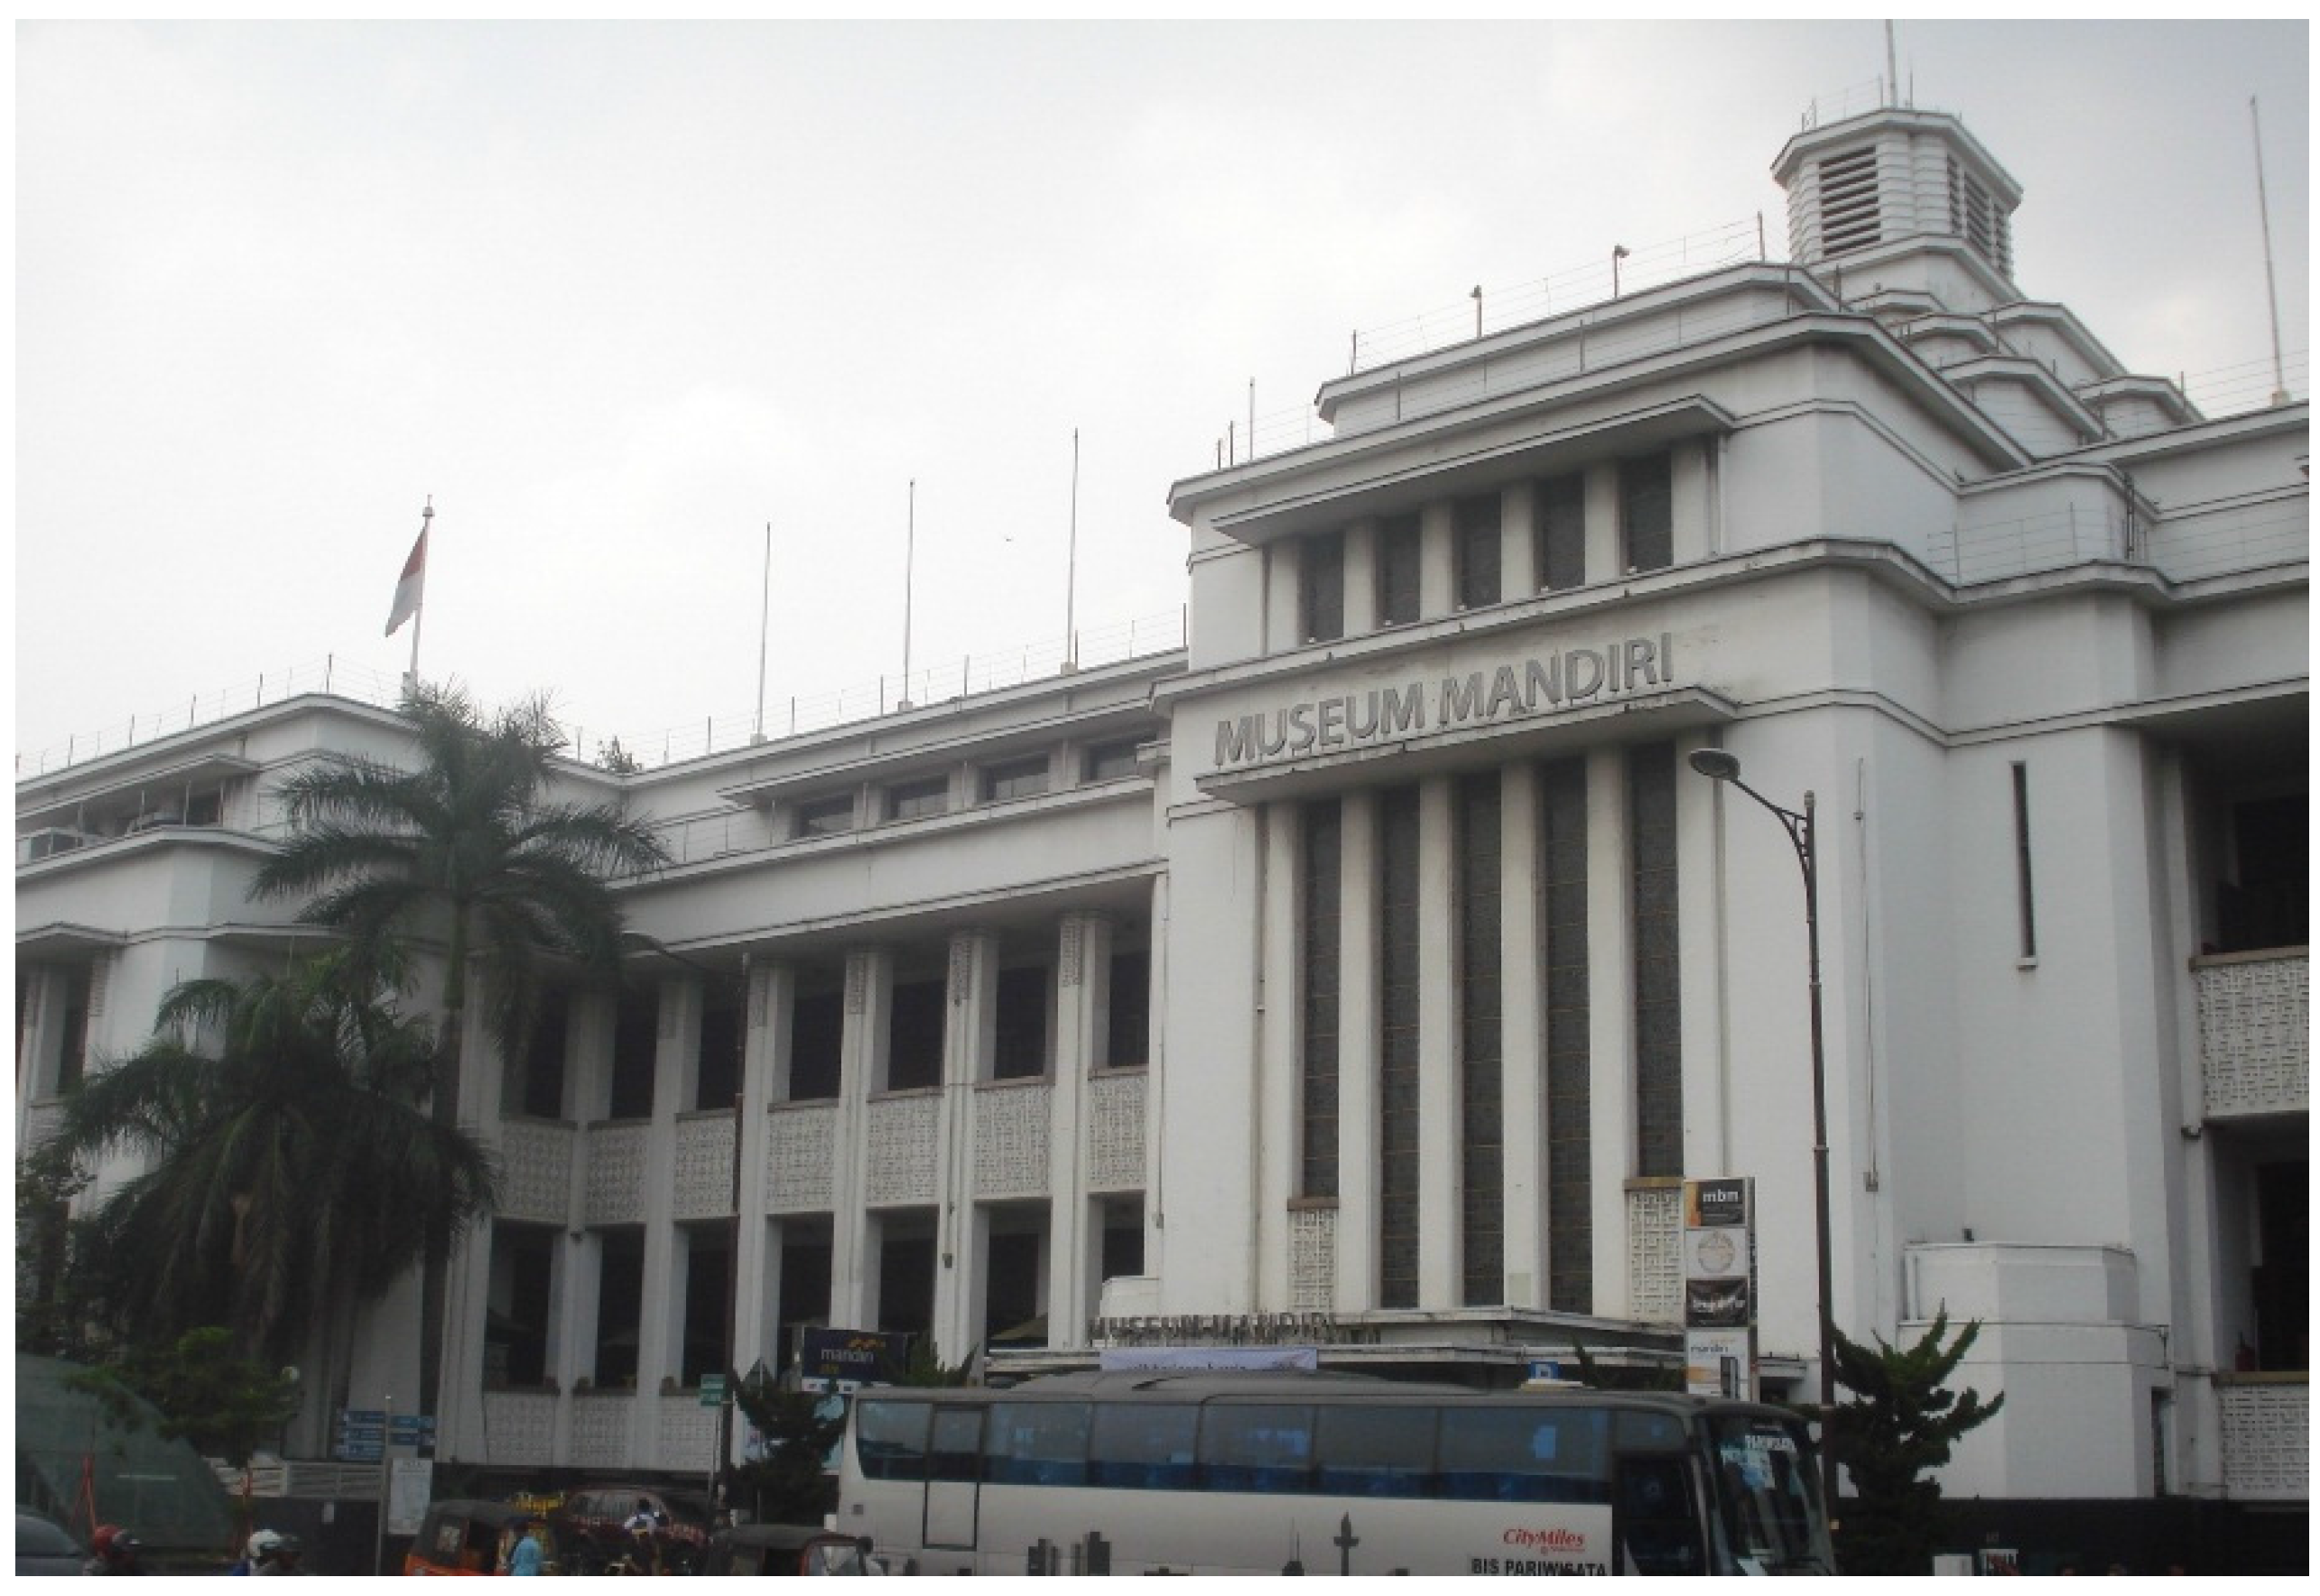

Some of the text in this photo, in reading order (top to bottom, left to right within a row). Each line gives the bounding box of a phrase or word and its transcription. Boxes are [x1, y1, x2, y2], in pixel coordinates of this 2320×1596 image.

[1214, 632, 1675, 767] MUSEUM MANDIRI
[1471, 1558, 1499, 1574] BIS
